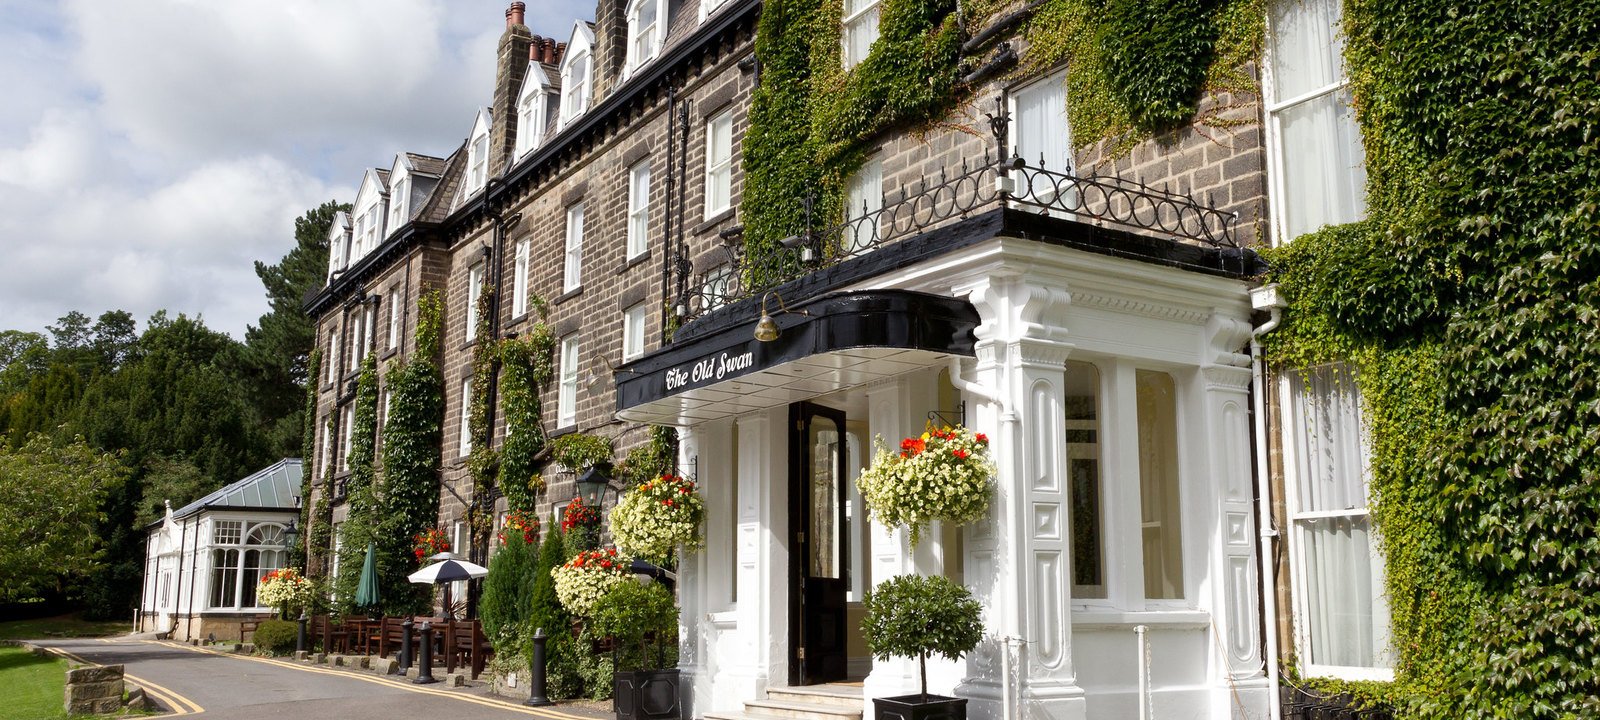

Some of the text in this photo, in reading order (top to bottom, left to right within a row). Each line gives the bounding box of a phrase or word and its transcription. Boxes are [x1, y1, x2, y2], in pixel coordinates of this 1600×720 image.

[665, 351, 753, 390] The Old Swan
